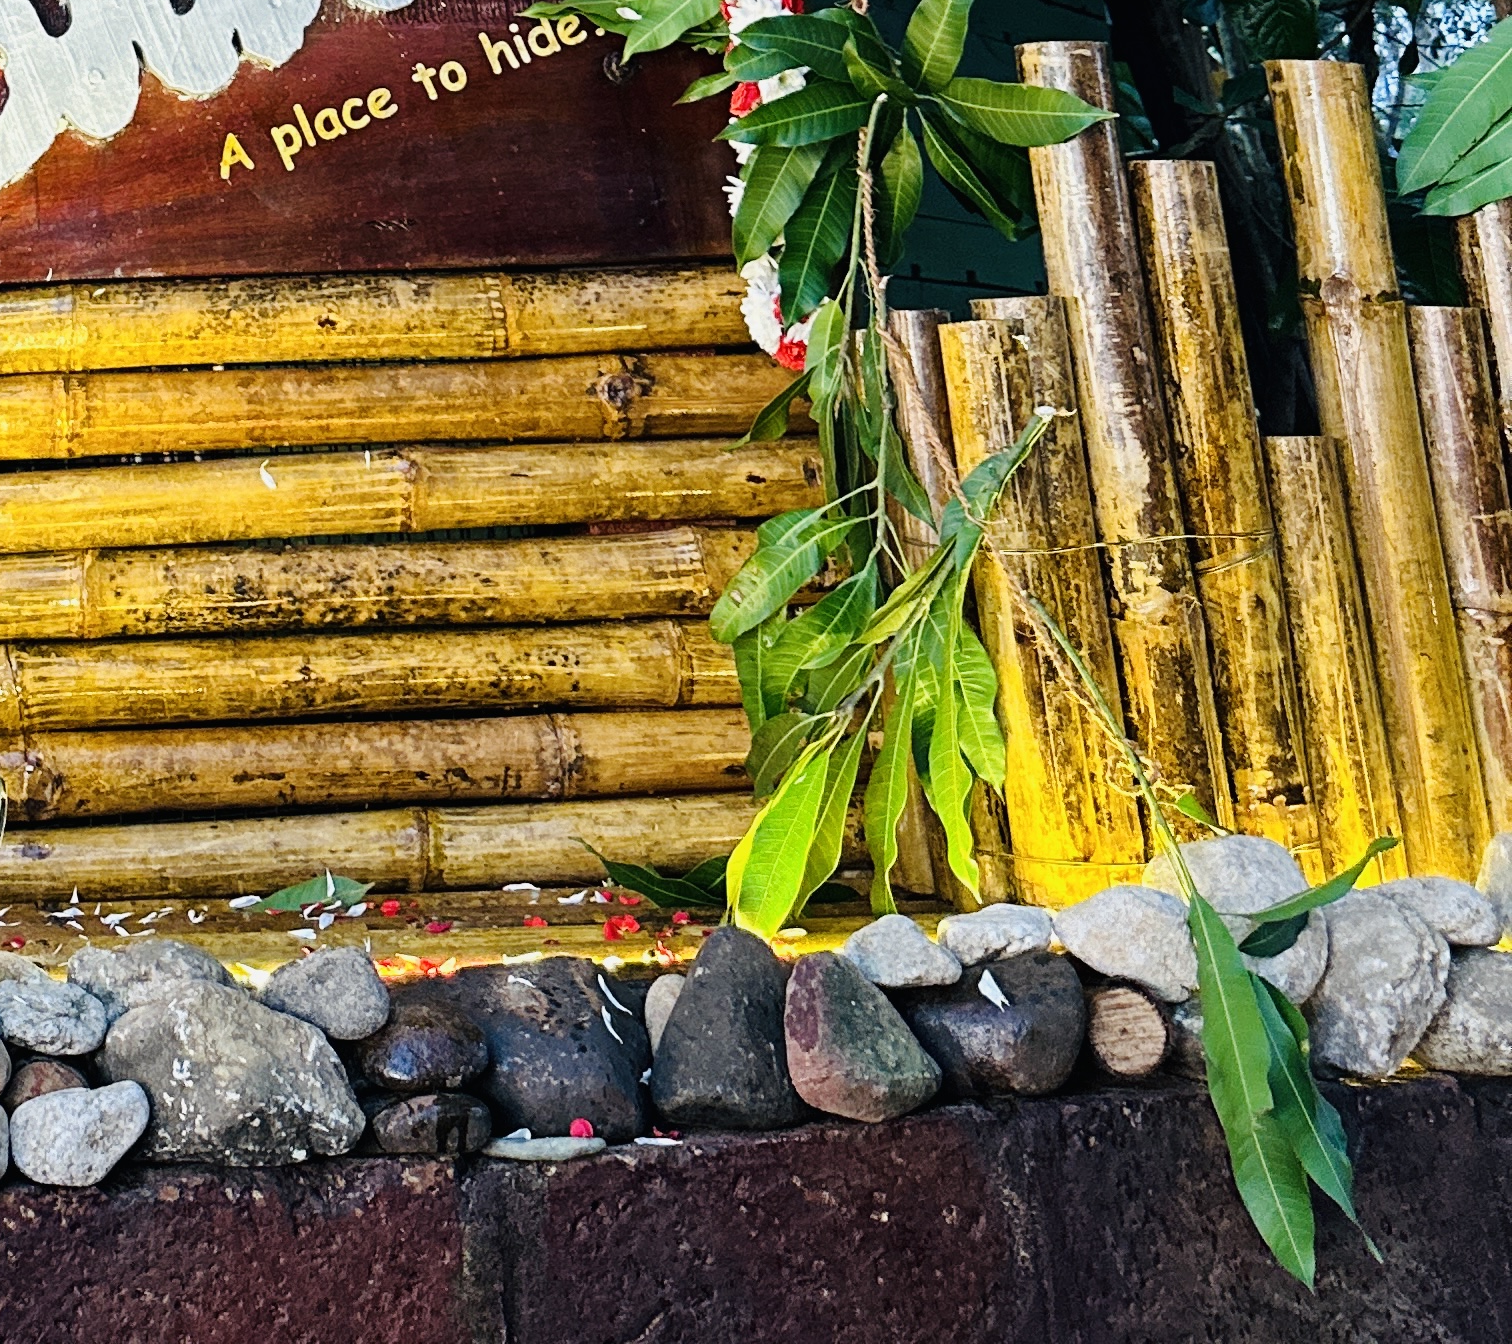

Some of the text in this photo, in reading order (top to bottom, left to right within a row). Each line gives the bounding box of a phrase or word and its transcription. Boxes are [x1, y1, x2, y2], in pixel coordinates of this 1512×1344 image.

[219, 132, 255, 180] A
[270, 87, 399, 172] place
[411, 60, 468, 101] to
